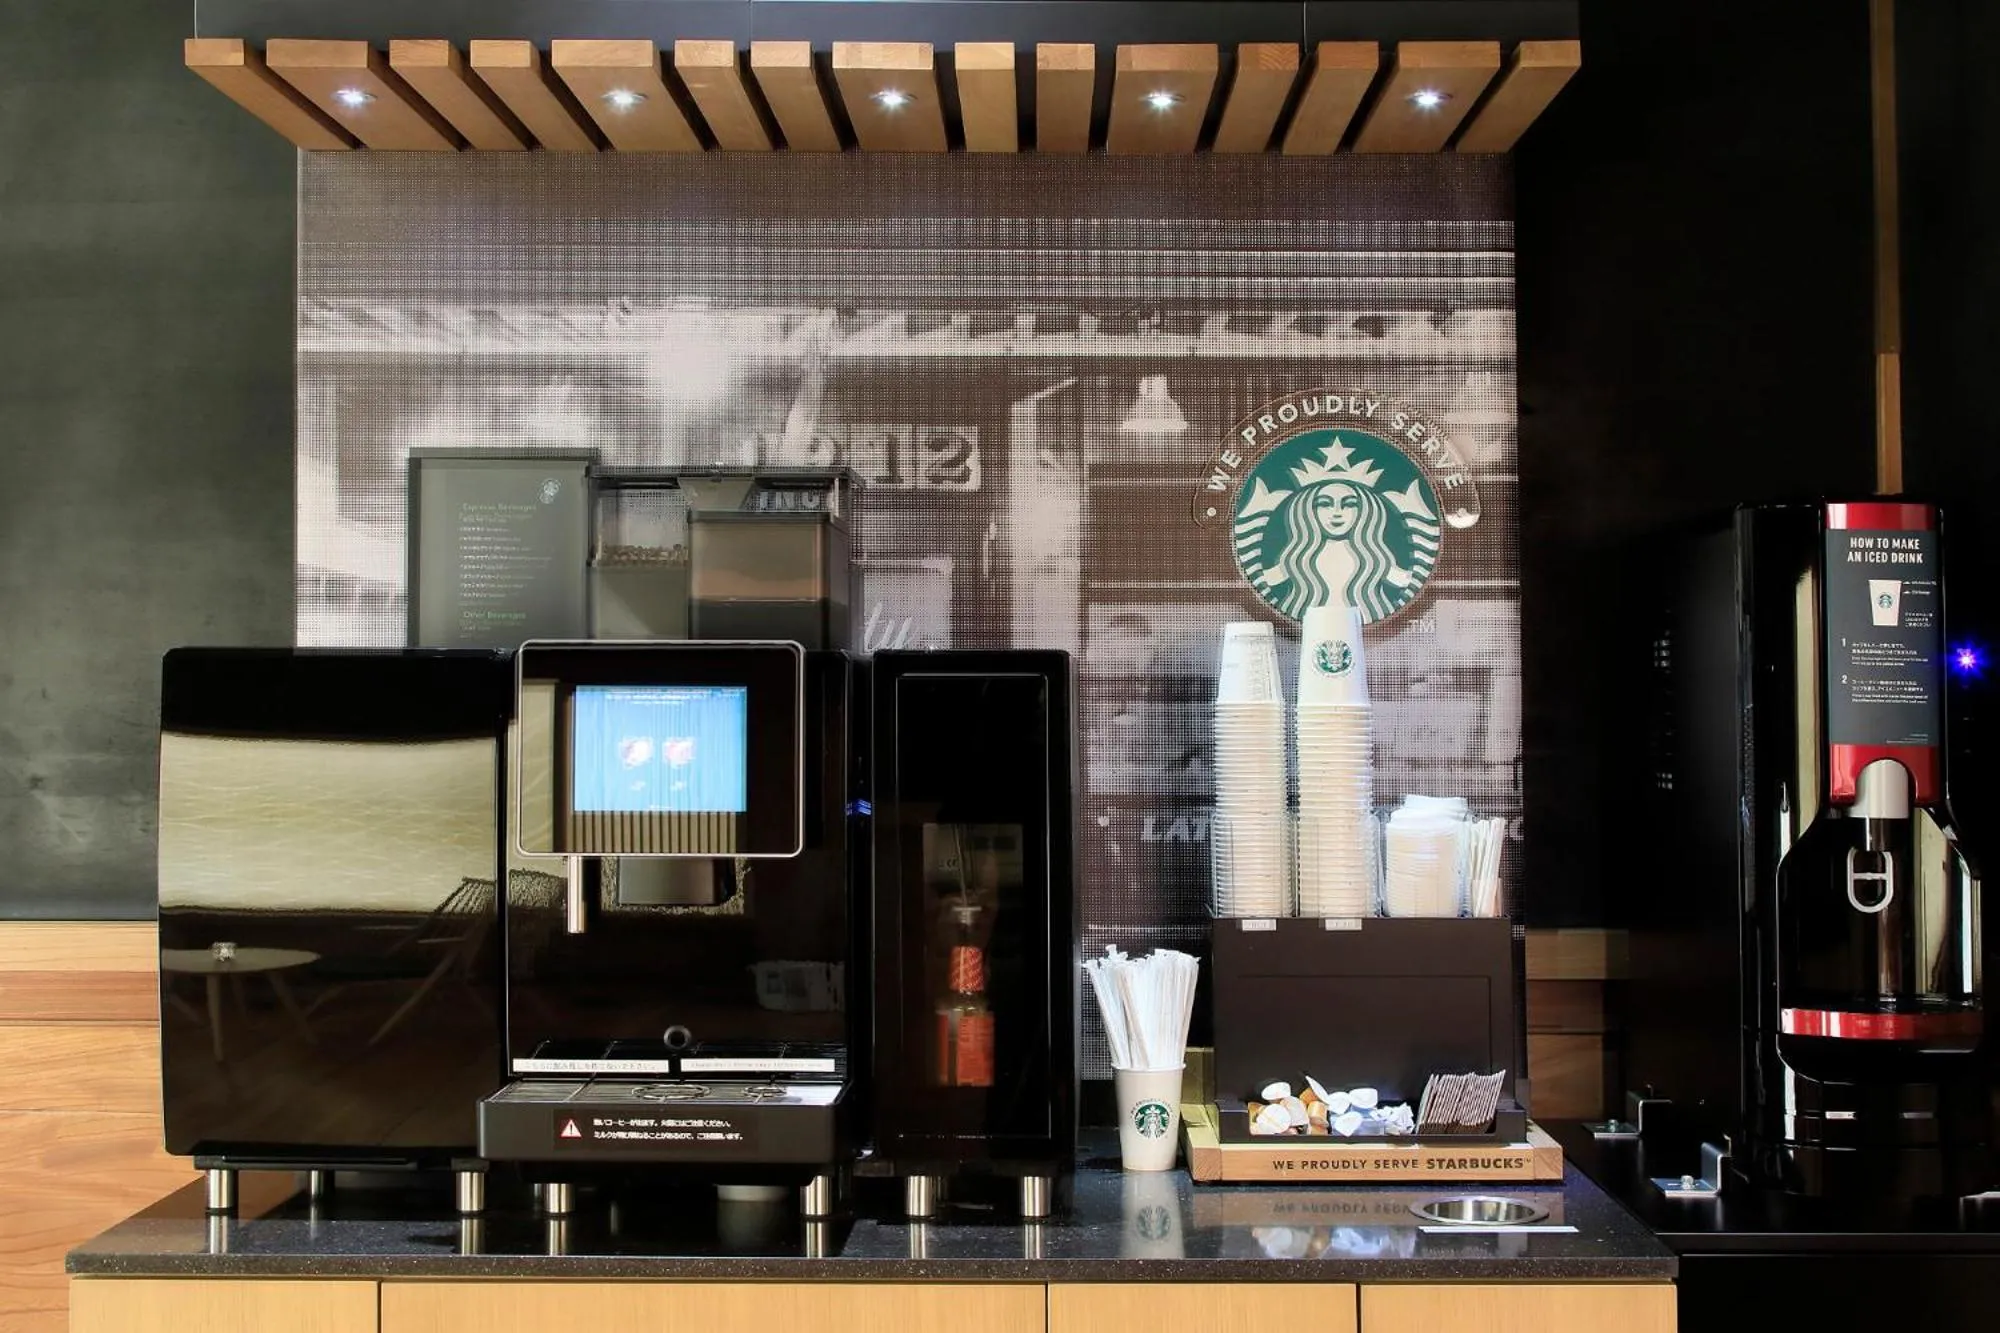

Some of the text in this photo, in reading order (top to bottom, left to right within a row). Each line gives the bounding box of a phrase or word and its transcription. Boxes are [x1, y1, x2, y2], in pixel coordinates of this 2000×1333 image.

[1207, 395, 1465, 494] WE PROUDLY SERVE
[1850, 537, 1920, 550] HOW TO MAKE
[1847, 551, 1923, 564] AN ICED DRINK
[1841, 637, 1847, 648] 1
[1841, 674, 1848, 685] 2
[1273, 1159, 1294, 1170] WE
[1301, 1159, 1368, 1170] PROUDLY
[1373, 1158, 1419, 1169] SERVE
